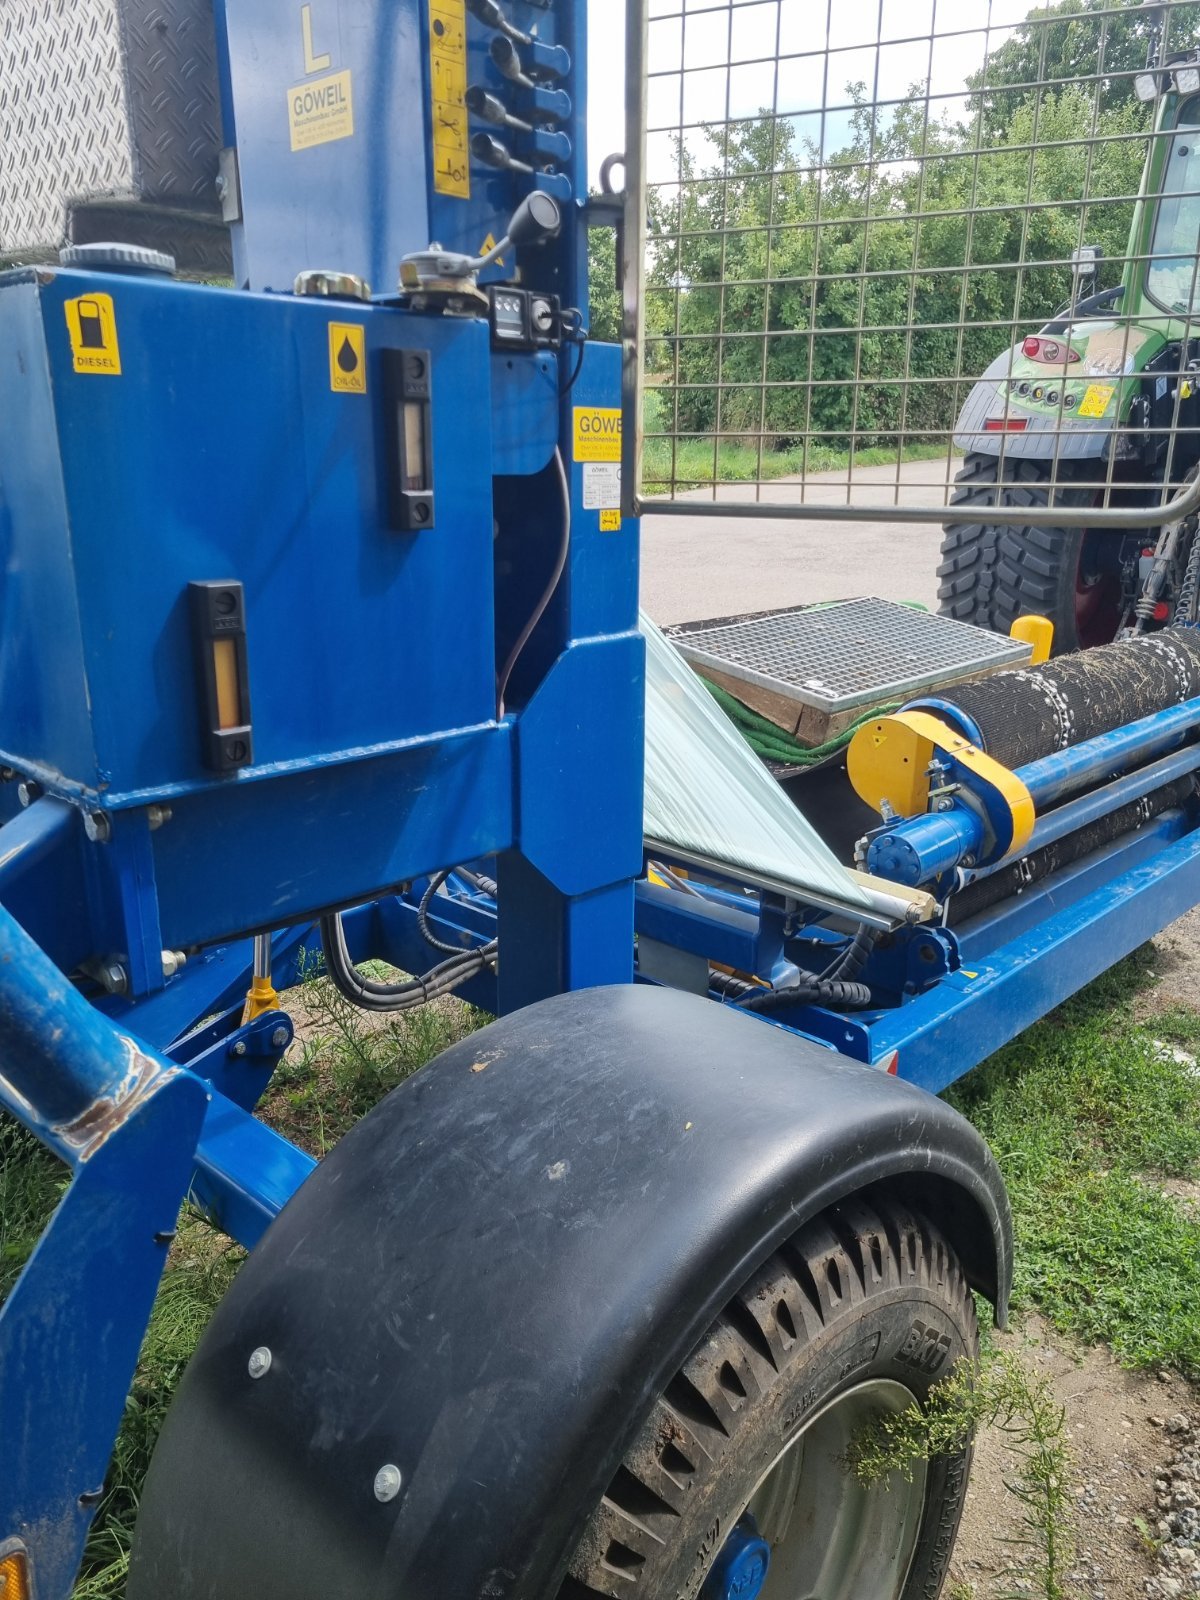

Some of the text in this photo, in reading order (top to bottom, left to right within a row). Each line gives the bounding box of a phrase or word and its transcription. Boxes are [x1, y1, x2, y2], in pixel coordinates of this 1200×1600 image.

[301, 3, 331, 75] L
[293, 82, 346, 117] GÖWEIL
[77, 357, 115, 368] DIESEL
[580, 411, 622, 434] GÖWE
[893, 1319, 951, 1376] BKT
